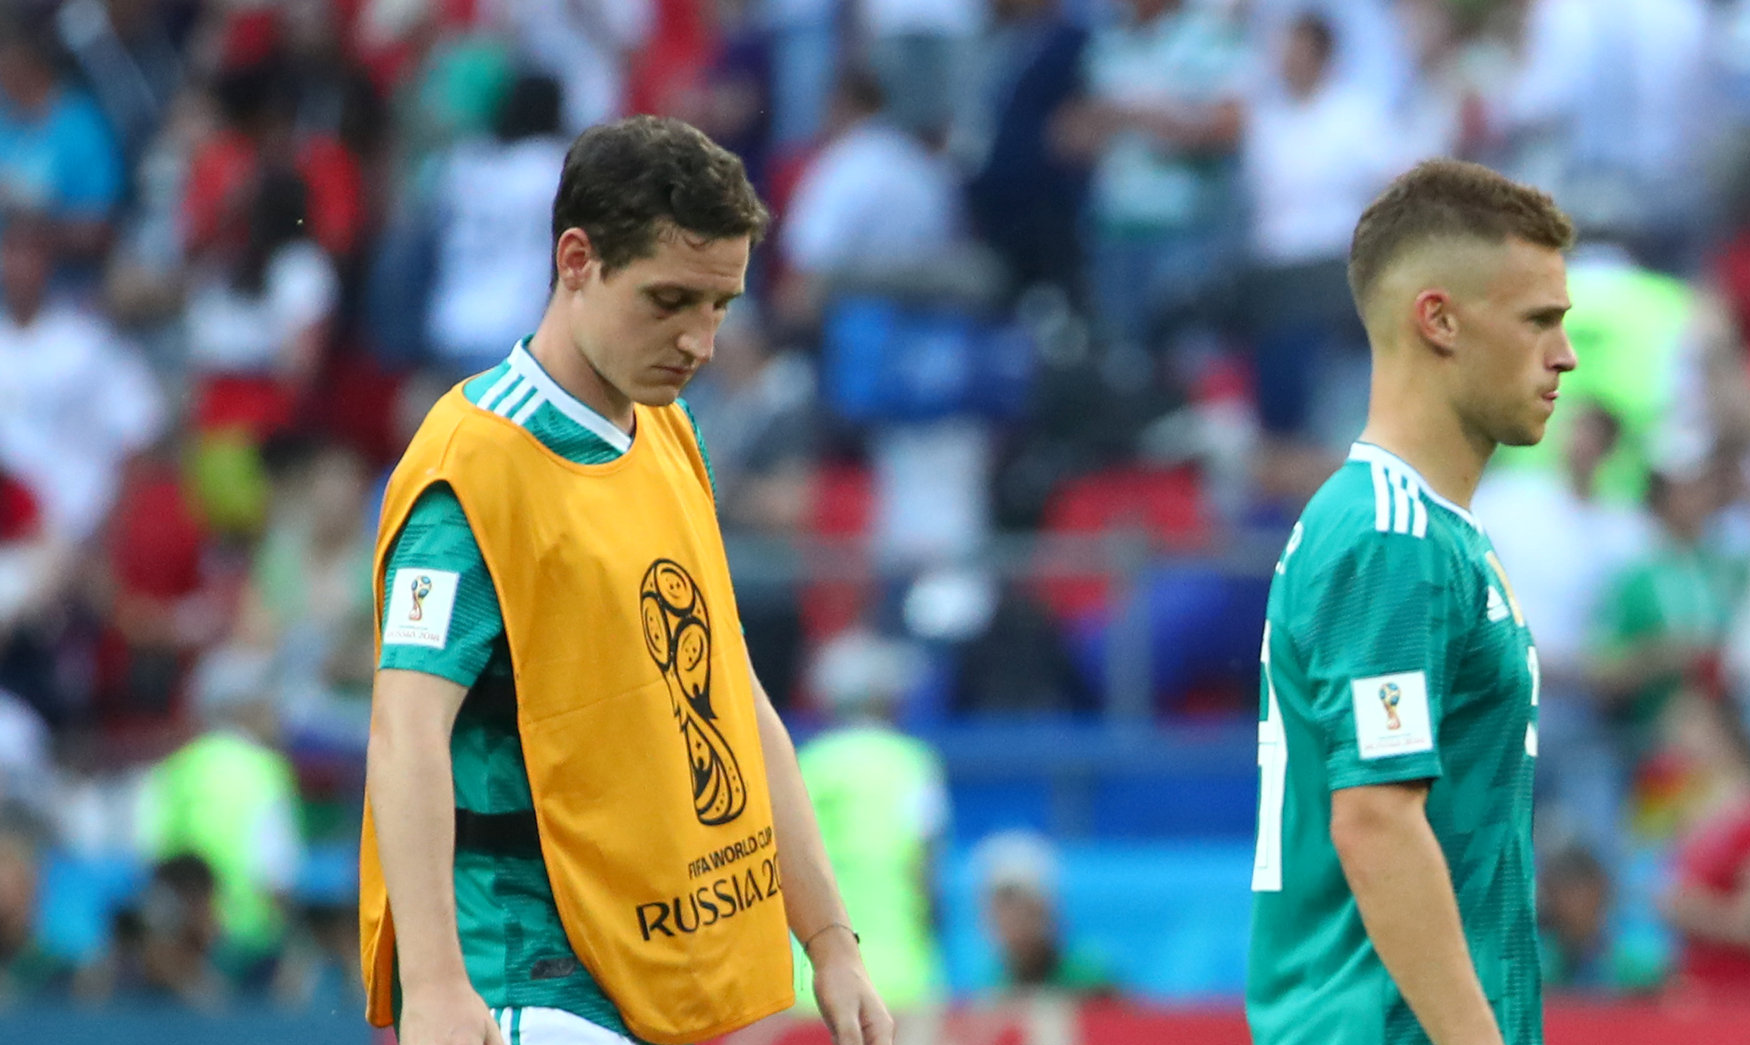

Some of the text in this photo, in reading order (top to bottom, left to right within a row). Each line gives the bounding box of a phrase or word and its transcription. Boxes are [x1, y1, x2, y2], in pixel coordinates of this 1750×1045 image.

[688, 826, 773, 880] FIFA WORLD CUP
[635, 867, 764, 942] RUSSIA
